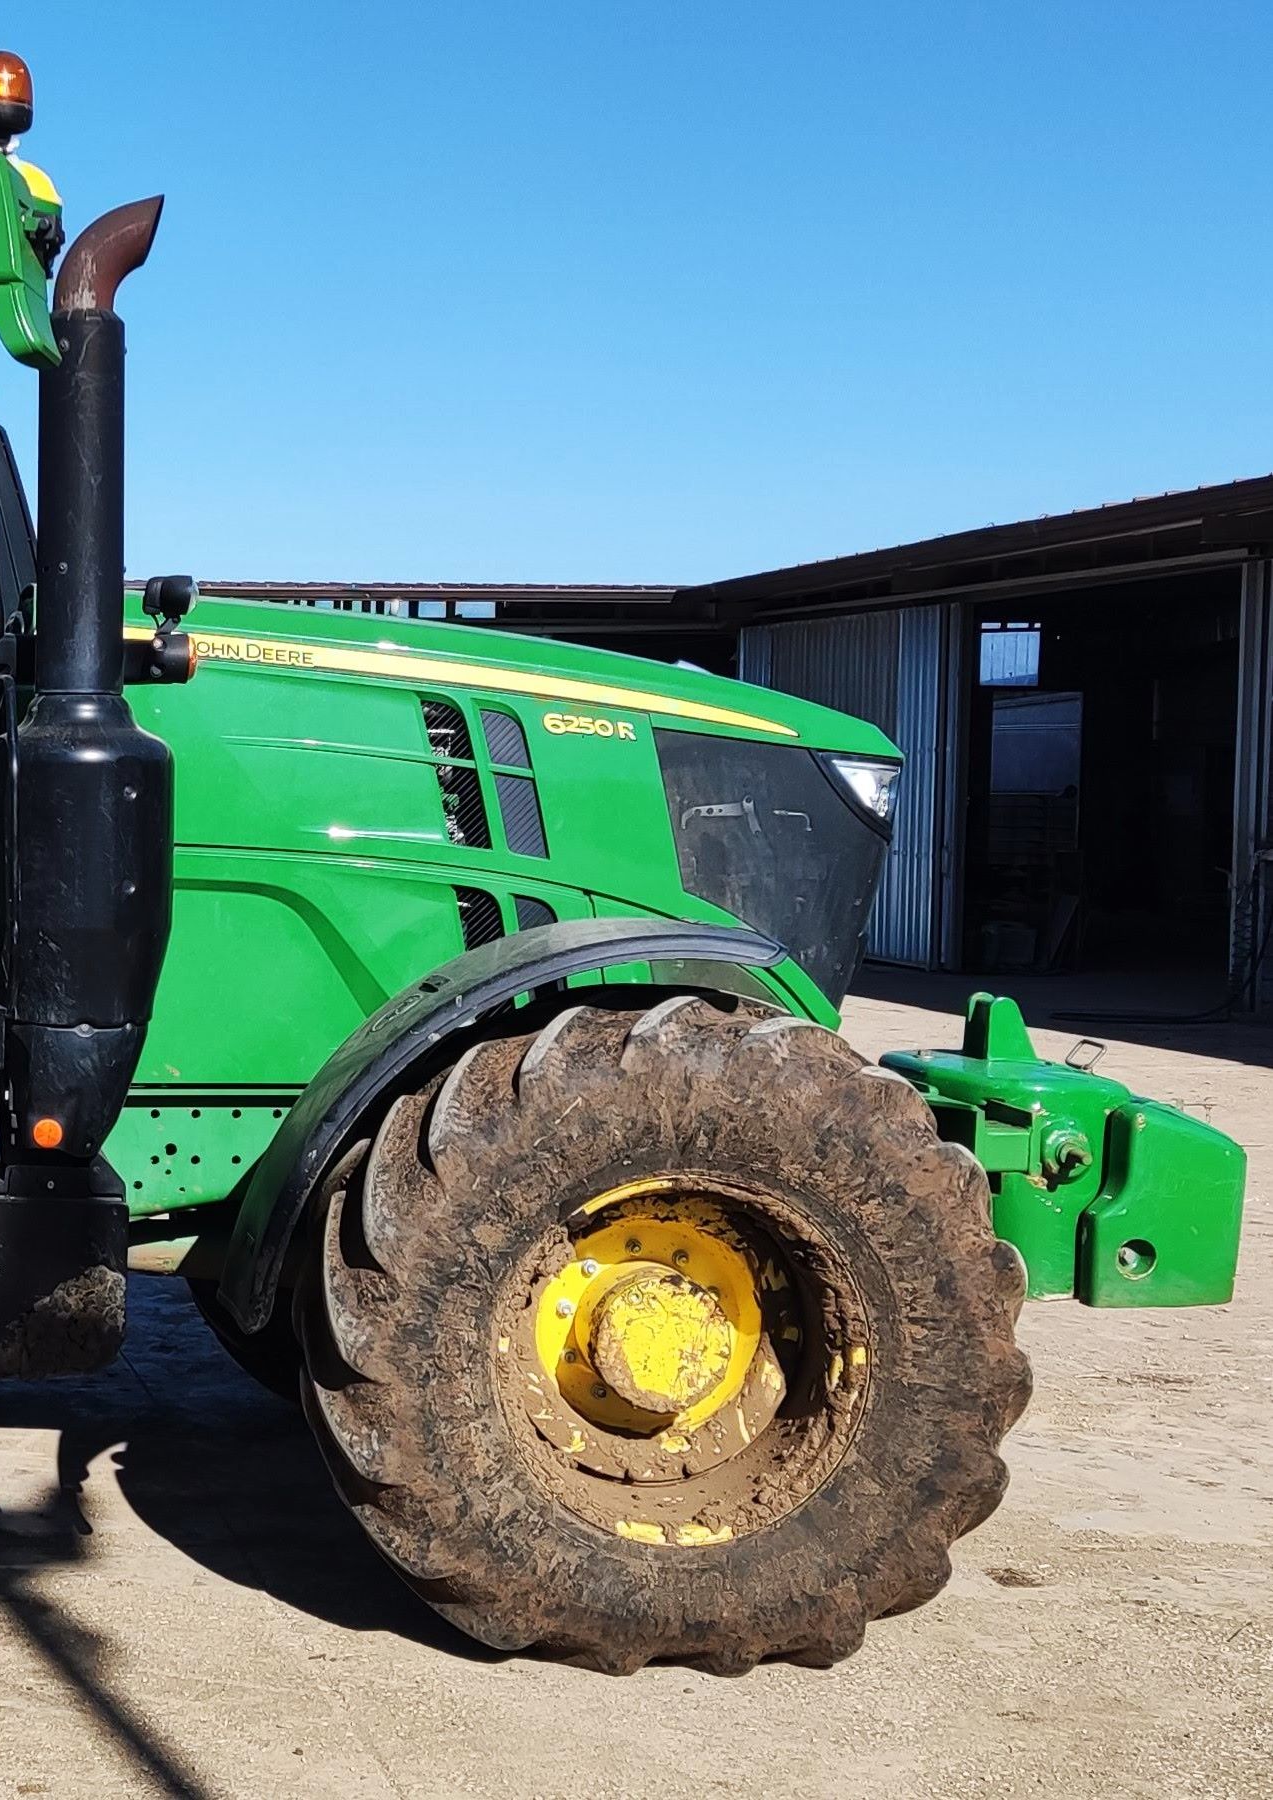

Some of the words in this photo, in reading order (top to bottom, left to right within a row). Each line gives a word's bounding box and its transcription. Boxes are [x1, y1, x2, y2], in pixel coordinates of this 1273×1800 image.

[195, 641, 240, 658] OHN
[246, 643, 314, 665] DEERE
[543, 713, 614, 737] 6250
[616, 721, 637, 741] R
